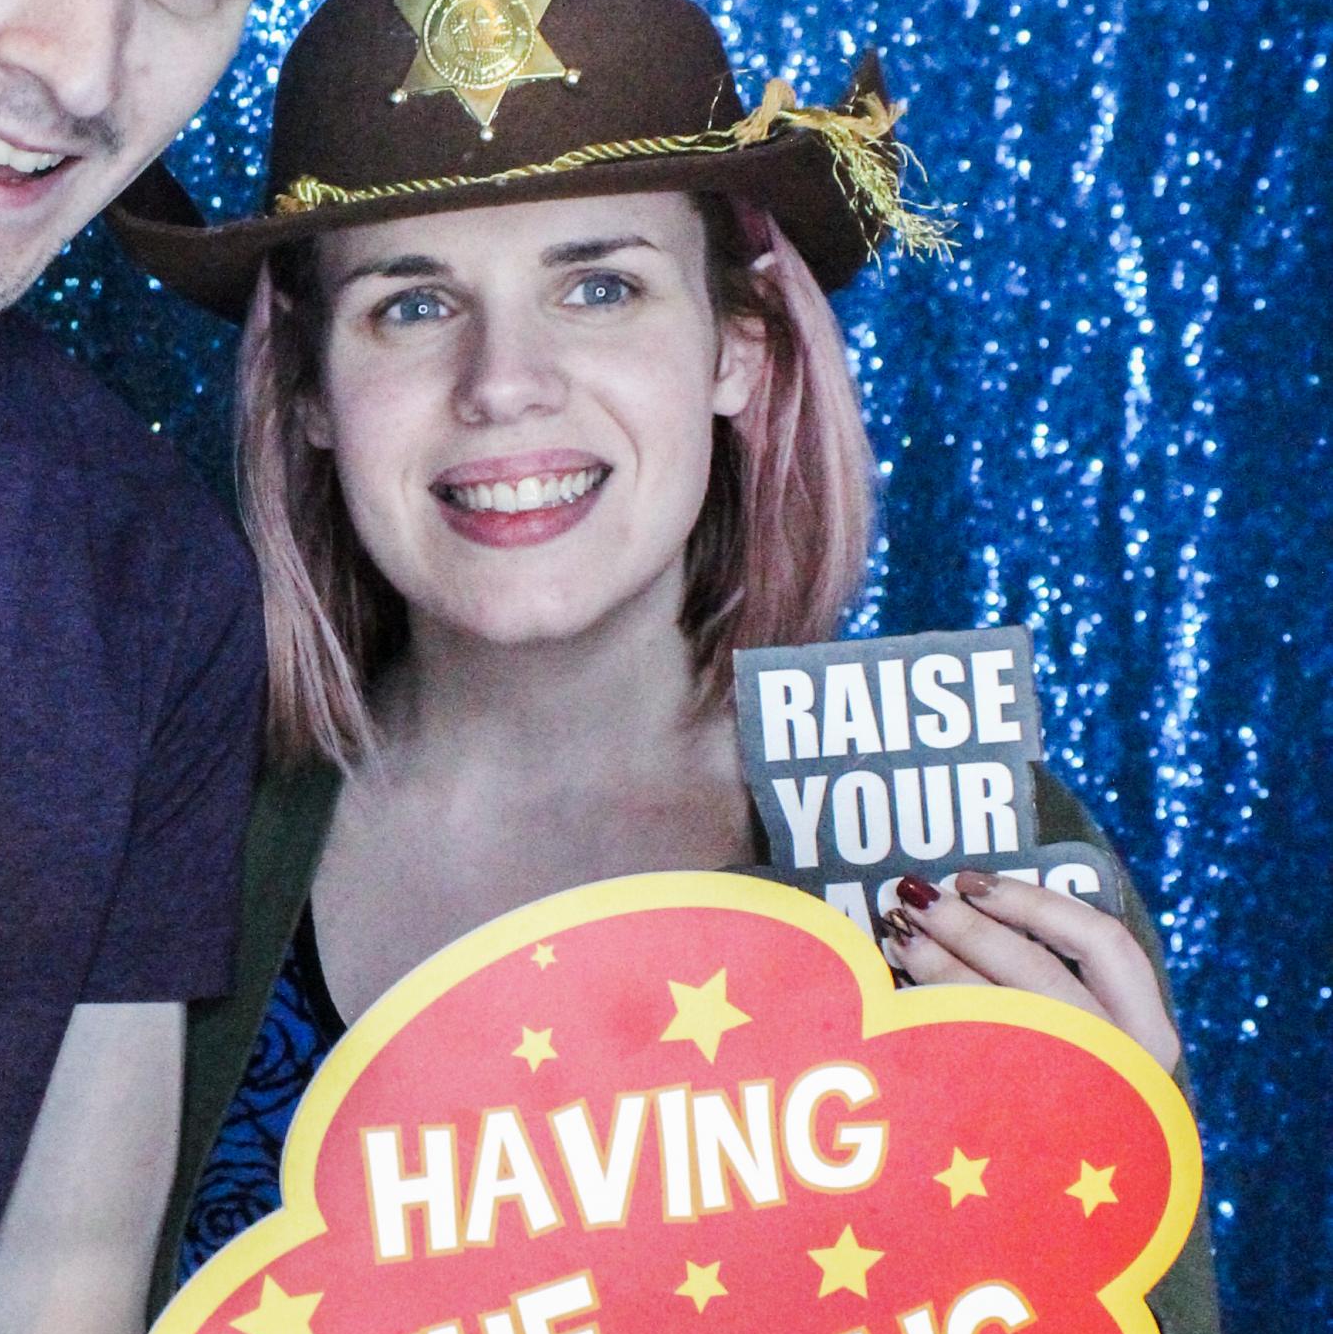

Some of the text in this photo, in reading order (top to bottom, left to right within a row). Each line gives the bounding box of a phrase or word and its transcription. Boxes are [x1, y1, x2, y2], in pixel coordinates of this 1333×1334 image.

[757, 648, 1023, 763] RAISE
[771, 761, 1020, 868] YOUR
[362, 1063, 886, 1260] HAVING
